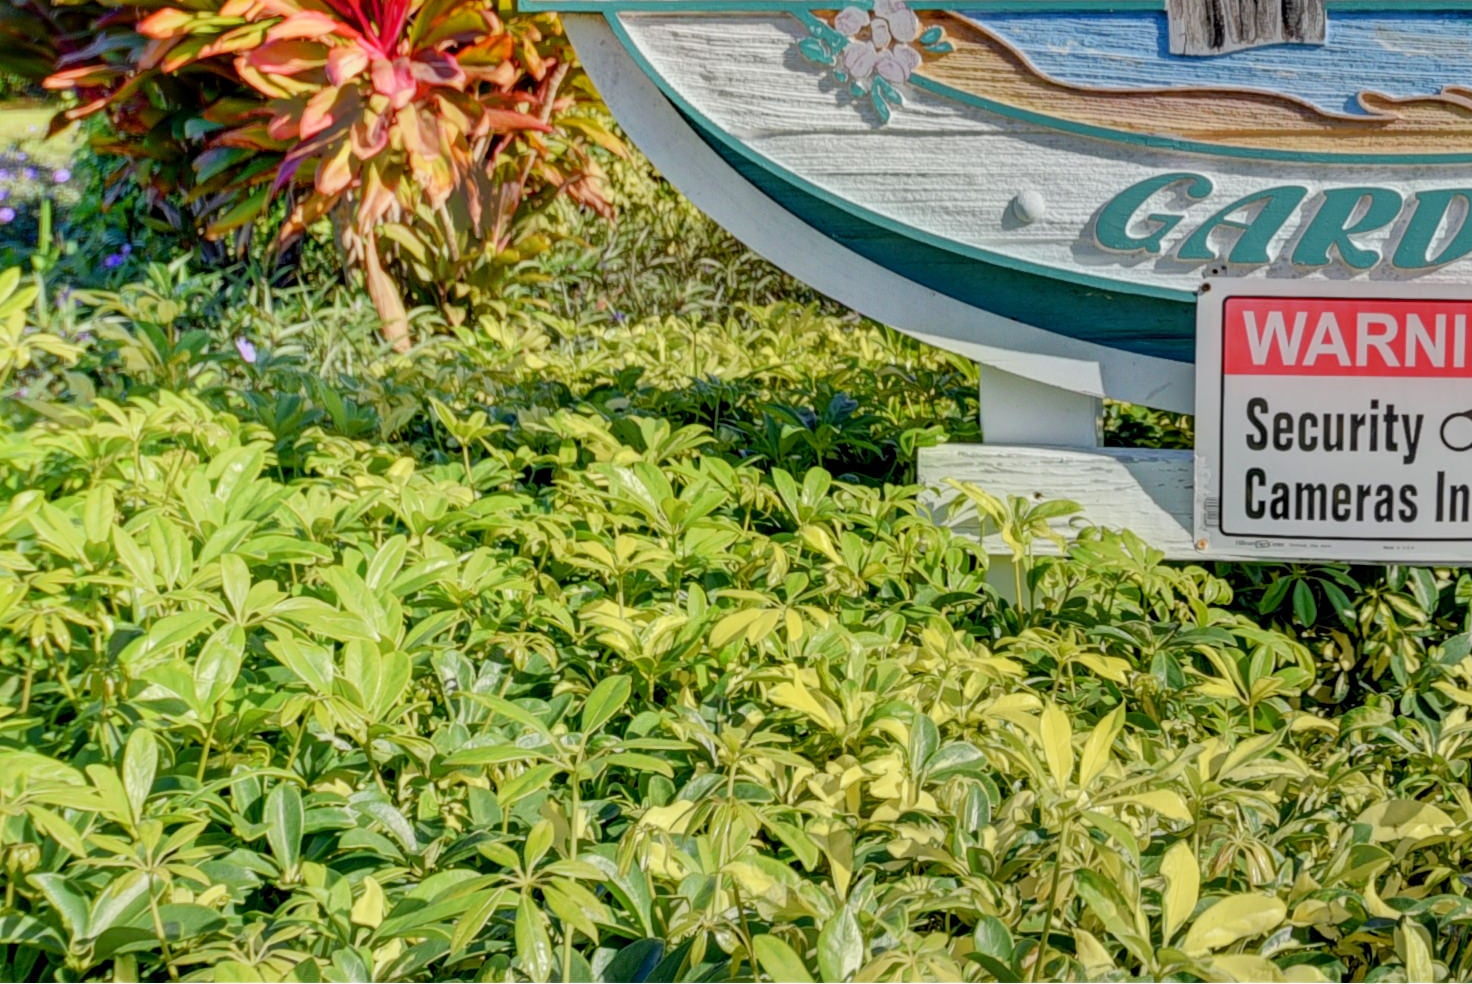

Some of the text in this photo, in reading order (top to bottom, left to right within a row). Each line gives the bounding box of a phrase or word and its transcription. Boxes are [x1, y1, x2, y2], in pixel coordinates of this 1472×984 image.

[1246, 397, 1424, 465] Security
[1245, 468, 1418, 523] Cameras
[1436, 471, 1470, 523] In
